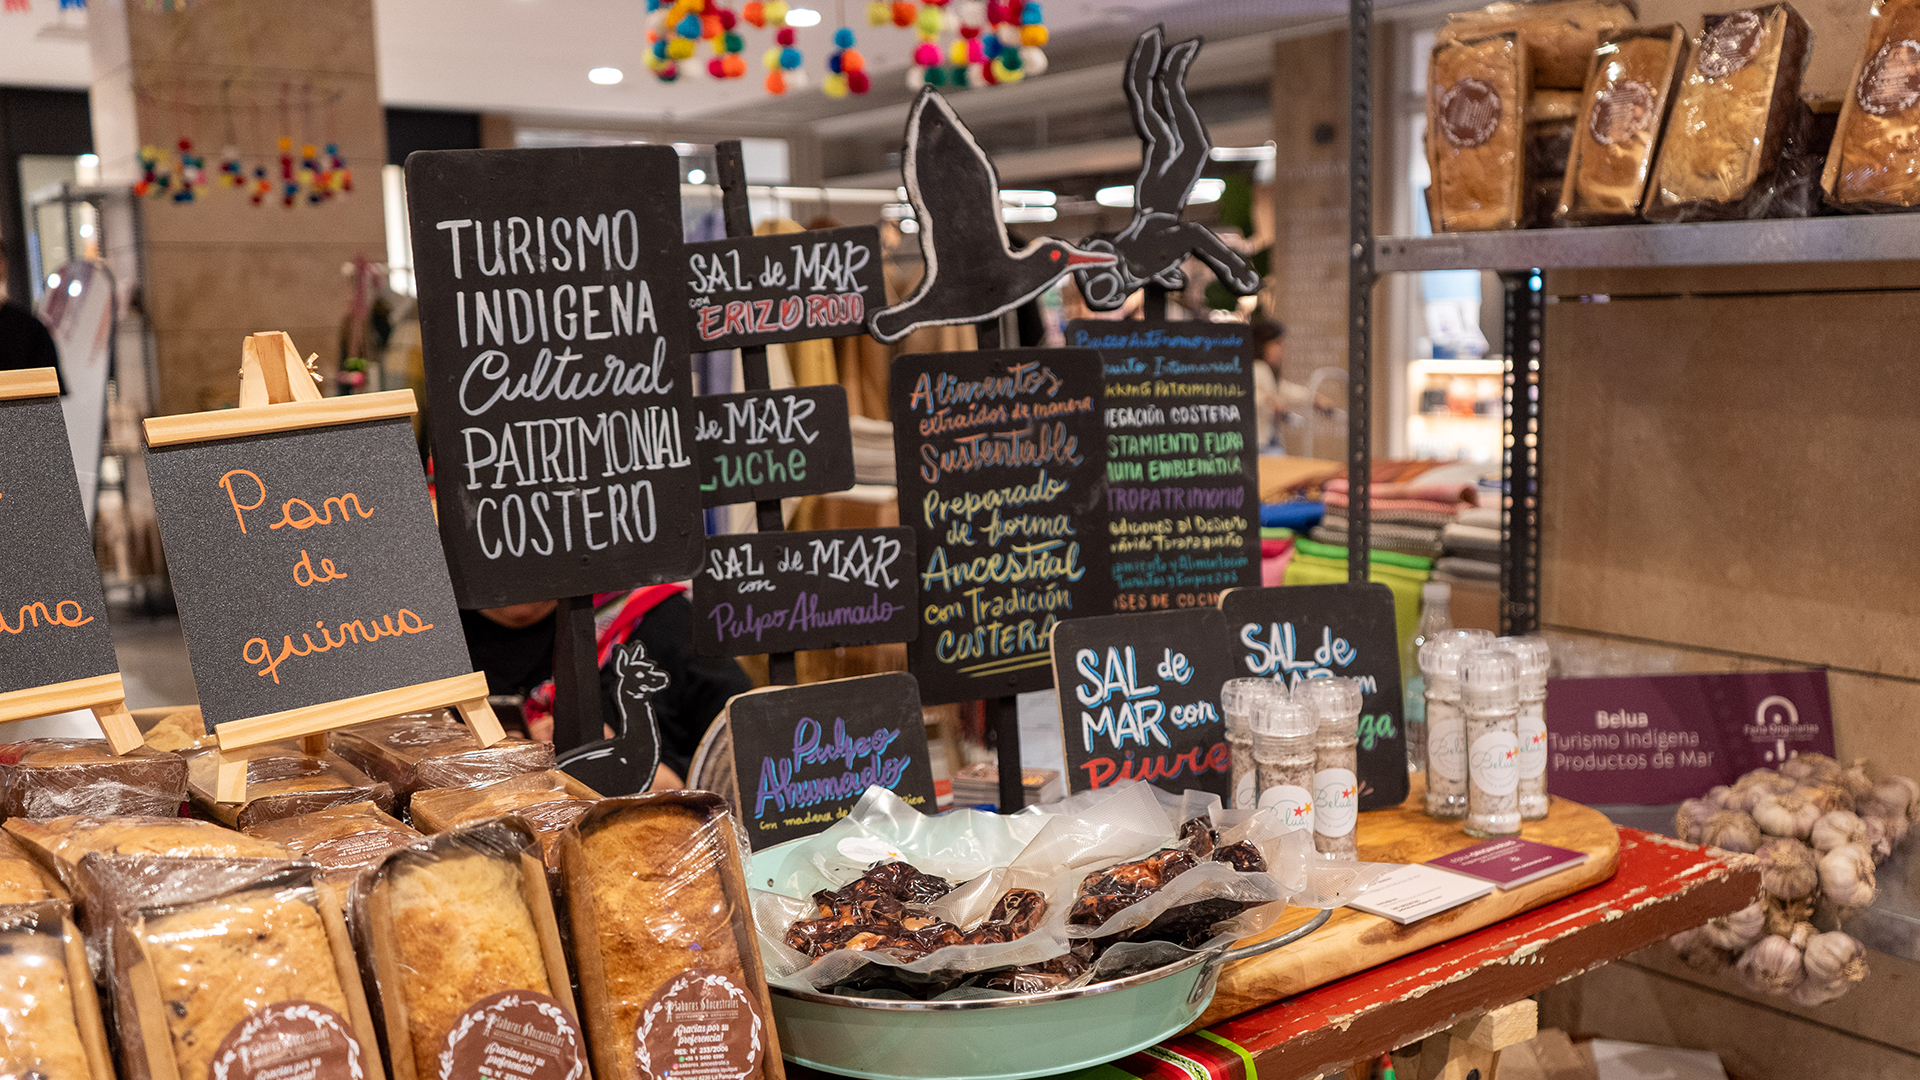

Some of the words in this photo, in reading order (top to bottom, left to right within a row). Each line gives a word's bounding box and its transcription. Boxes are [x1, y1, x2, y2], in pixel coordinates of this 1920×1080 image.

[436, 208, 640, 279] TURISMO
[688, 248, 752, 294] SAL
[759, 255, 787, 288] de
[787, 240, 870, 293] MAR
[456, 279, 658, 348] INDIGENA
[697, 295, 803, 342] ERIZO
[806, 292, 865, 328] ROJO
[459, 335, 674, 416] Cultural
[910, 361, 1064, 414] Alimentos
[723, 394, 819, 445] MAR
[1011, 402, 1031, 420] de
[1033, 396, 1095, 418] manera
[1169, 404, 1242, 425] COSTERA
[460, 405, 691, 490] PATRIMONIAL
[920, 421, 1085, 484] Sustentable
[219, 469, 374, 534] Pan
[476, 479, 657, 560] COSTERO
[923, 468, 1070, 529] Preparado
[946, 519, 977, 546] de
[980, 509, 1077, 547] forma
[293, 550, 347, 587] de
[706, 542, 764, 582] SAL
[777, 547, 805, 573] de
[805, 535, 900, 589] MAR
[738, 579, 776, 594] con
[921, 540, 1086, 591] Ancestral
[709, 602, 789, 642] Pulpo
[788, 592, 905, 631] Ahumado
[924, 601, 965, 625] con
[935, 613, 1057, 663] COSTERA
[243, 608, 434, 684] quinua
[1240, 621, 1315, 676] SAL
[1313, 625, 1357, 667] de
[1076, 646, 1159, 708] SAL
[1157, 648, 1194, 685] de
[793, 717, 900, 773] Pulpo
[1081, 700, 1171, 753] MAR
[1169, 701, 1219, 730] con
[1548, 731, 1620, 751] Turismo
[1595, 708, 1649, 729] Belua
[755, 754, 911, 819] Ahumado
[1080, 742, 1233, 790] Piure
[1553, 750, 1647, 772] Productos
[1653, 750, 1675, 769] de
[1680, 750, 1715, 769] Mar
